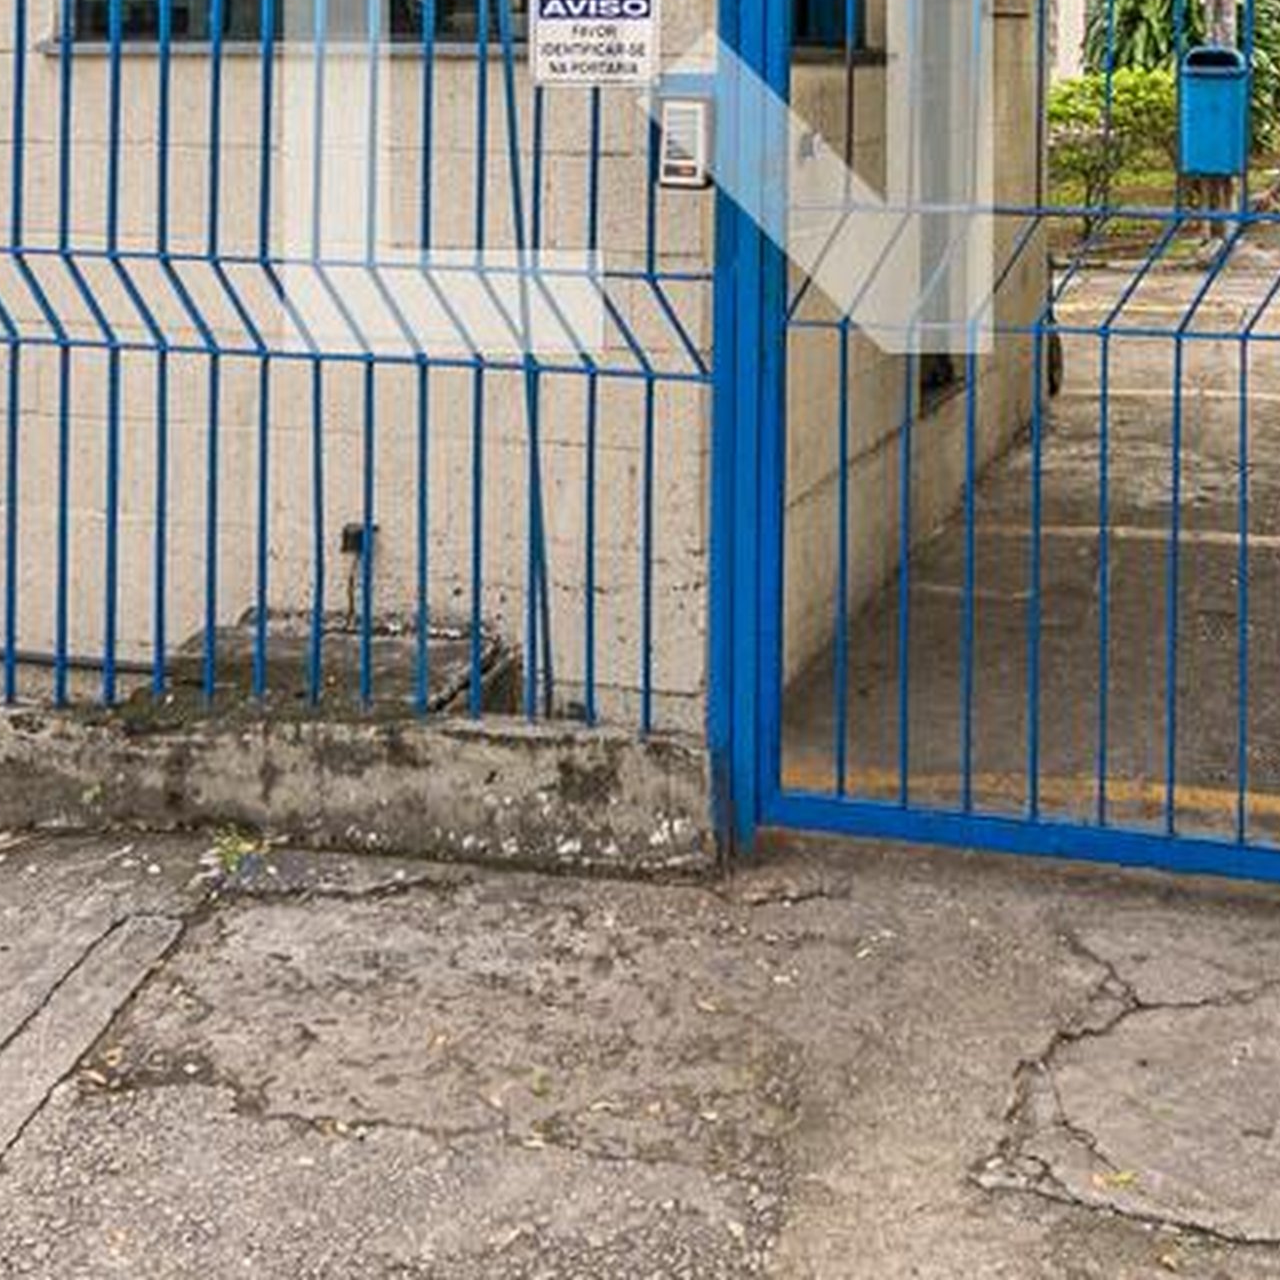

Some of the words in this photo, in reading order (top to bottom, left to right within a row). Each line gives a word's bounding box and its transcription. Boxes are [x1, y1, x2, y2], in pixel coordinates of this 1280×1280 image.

[543, 0, 648, 15] AVISO
[572, 24, 618, 38] FAVOR
[540, 41, 646, 58] IDENTIFICAR-SE
[570, 61, 638, 75] PORTARIA
